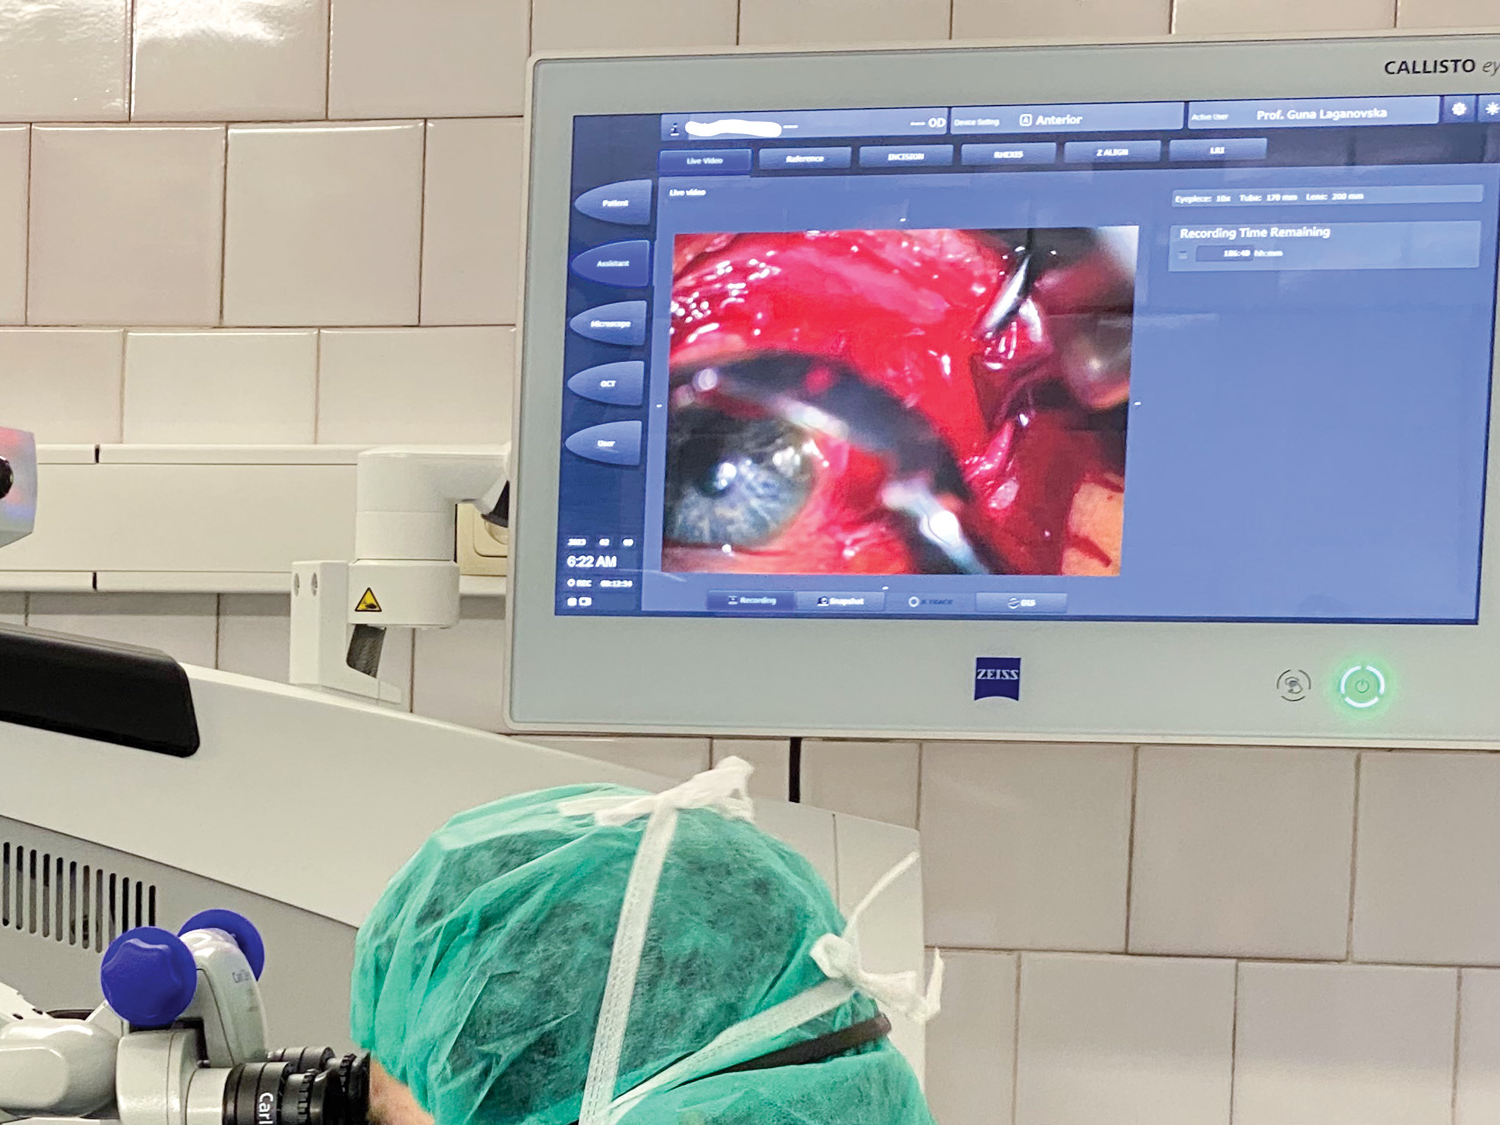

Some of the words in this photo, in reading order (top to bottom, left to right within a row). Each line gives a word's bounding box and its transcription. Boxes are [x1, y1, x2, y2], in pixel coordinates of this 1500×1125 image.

[1384, 59, 1476, 75] CALLISTO
[1036, 114, 1083, 126] Anterior
[1256, 110, 1284, 121] Prof.
[1287, 109, 1317, 121] Guna
[1319, 107, 1388, 121] Laganovska
[928, 117, 947, 128] OD
[686, 157, 702, 165] Live
[686, 188, 707, 196] video
[1180, 228, 1237, 241] Recording
[1239, 228, 1268, 239] Time
[1270, 226, 1332, 239] Remaining
[600, 380, 617, 388] OCT
[566, 554, 595, 567] 6:22
[595, 554, 617, 568] AM
[976, 668, 1019, 680] ZEISS
[258, 1092, 274, 1125] Carl
